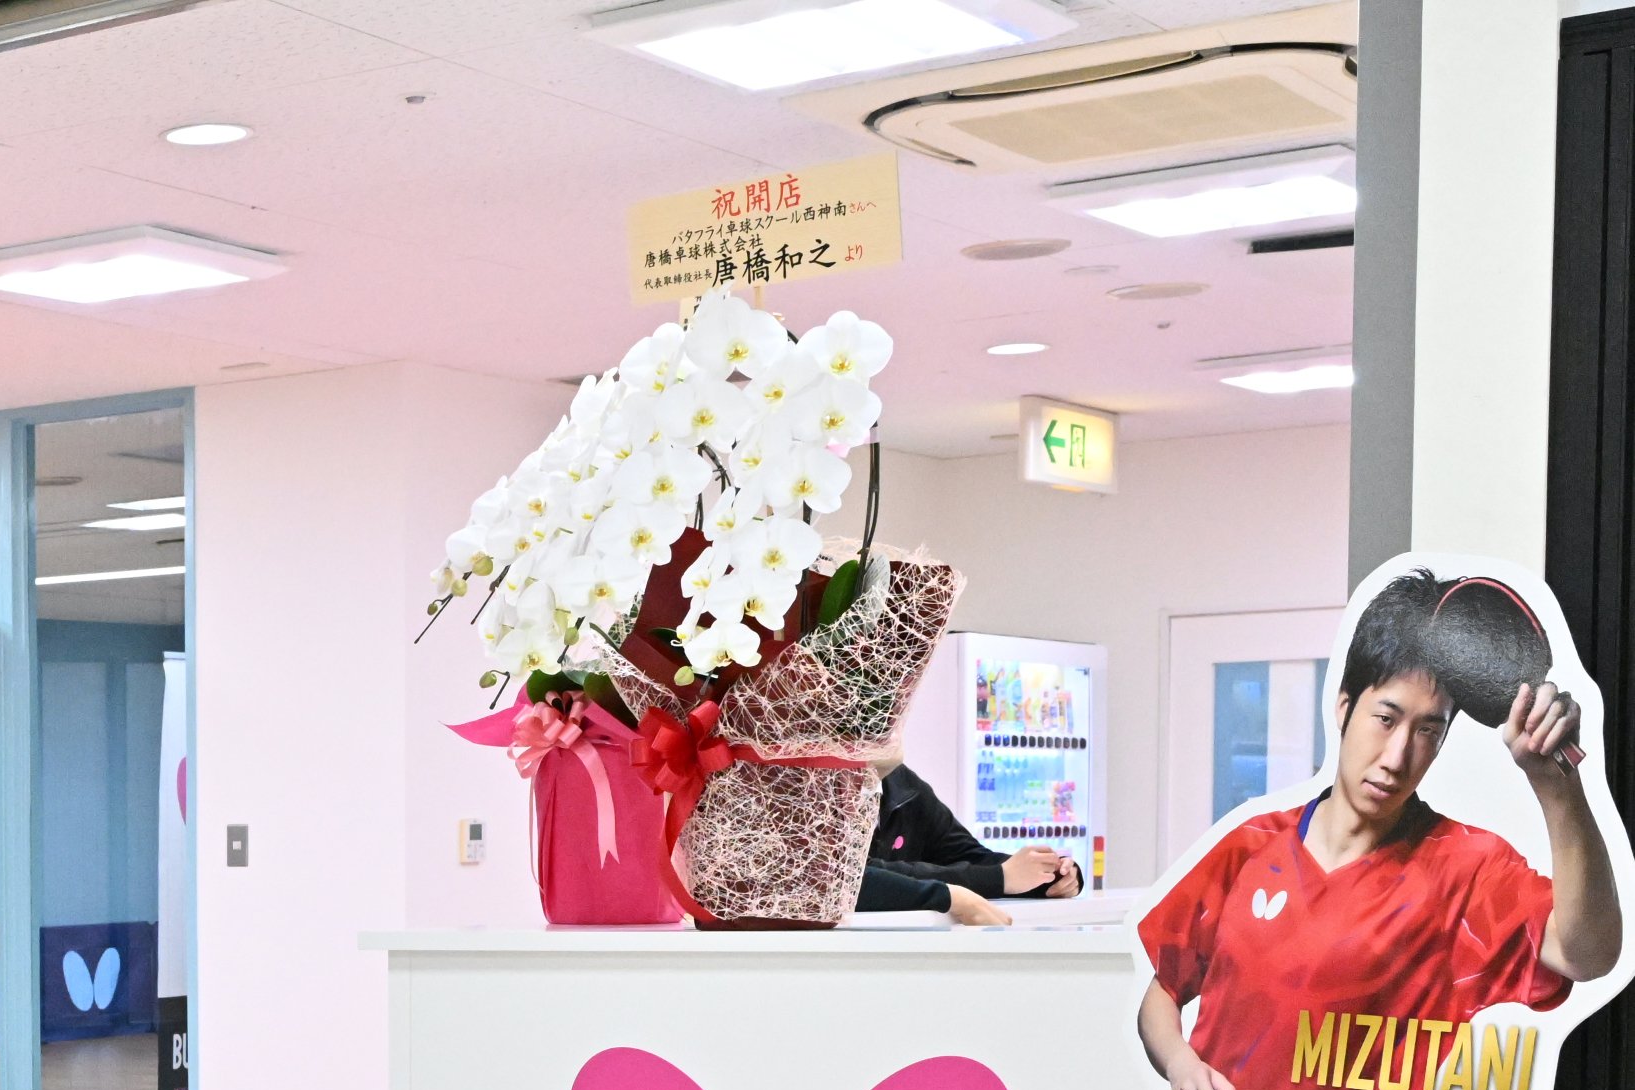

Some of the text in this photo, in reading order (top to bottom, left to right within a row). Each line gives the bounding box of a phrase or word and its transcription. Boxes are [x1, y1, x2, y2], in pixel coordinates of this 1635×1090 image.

[712, 174, 801, 220] 祝開店
[672, 200, 877, 245] バタフライ卓球スクール西神南さんへ
[643, 238, 864, 290] 代表取締役社長 唐橋和之 より
[644, 234, 763, 269] 唐橋卓球株式会社
